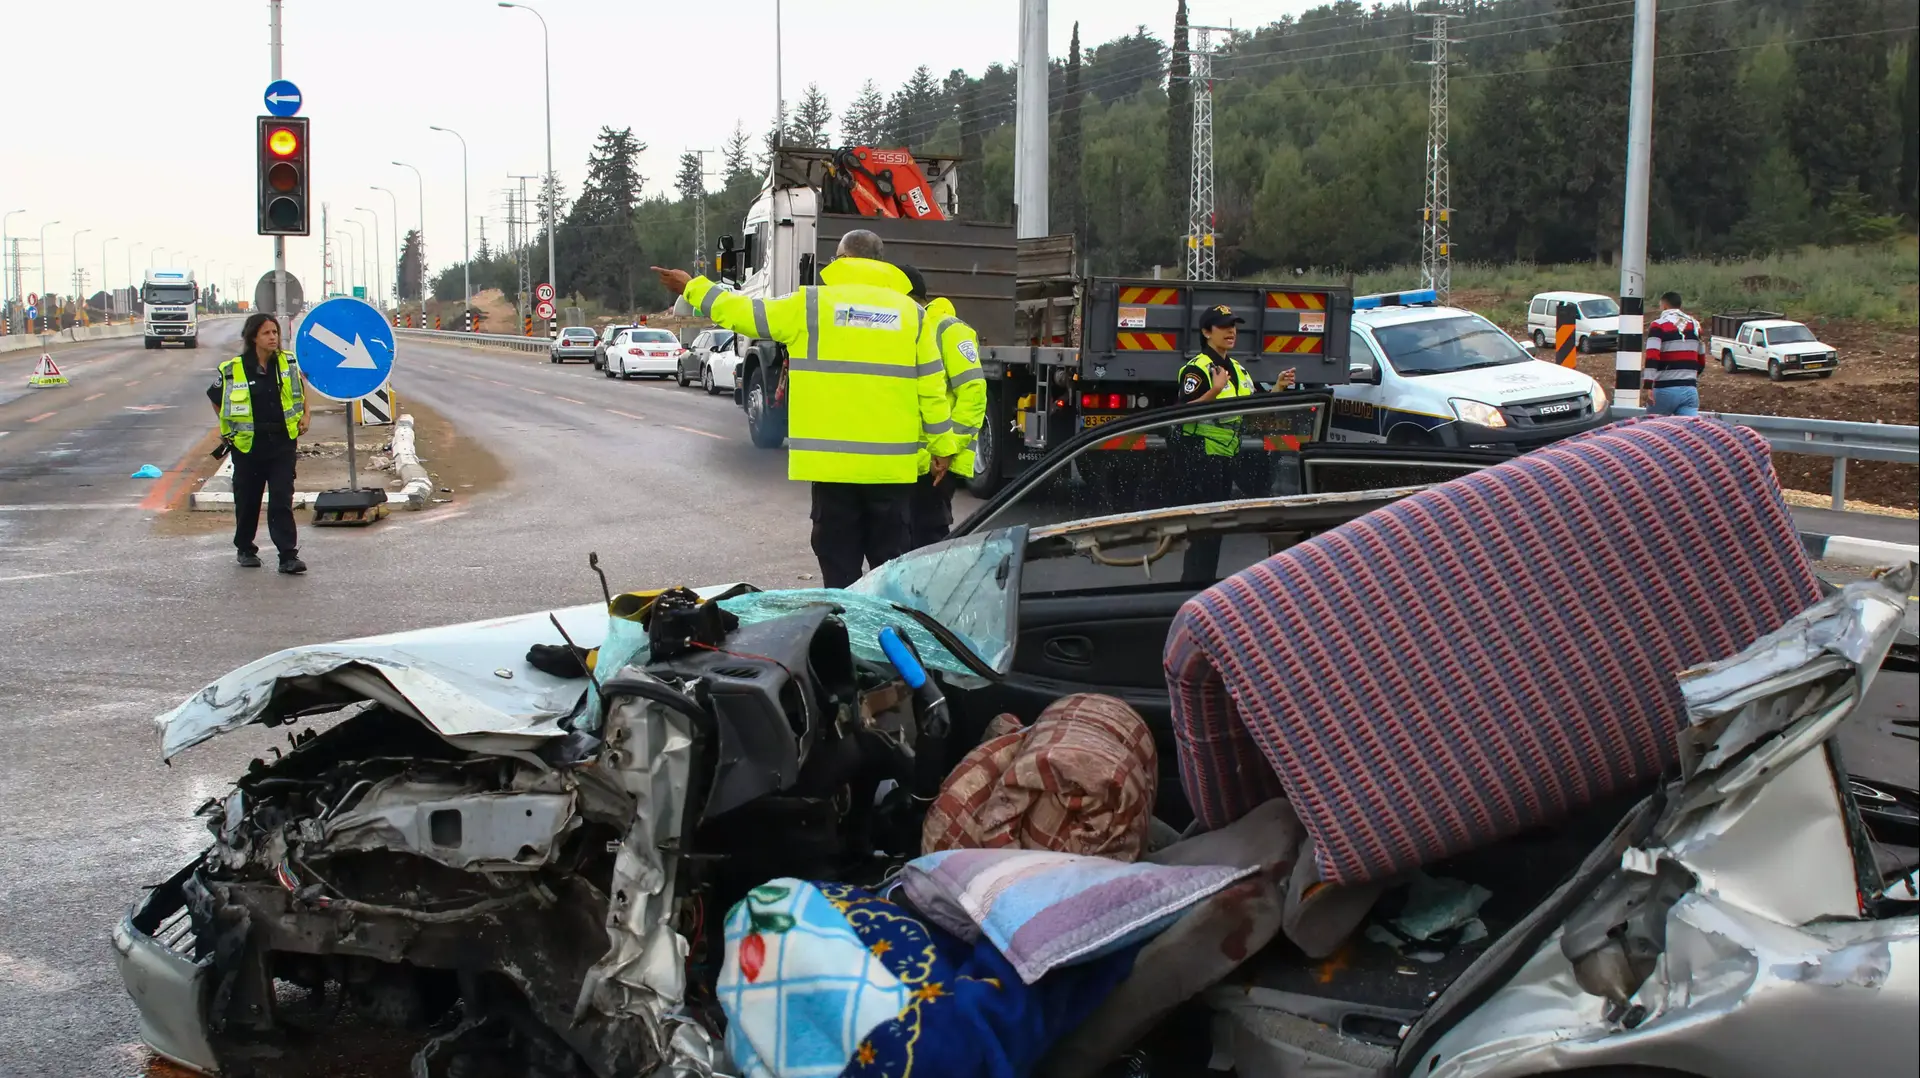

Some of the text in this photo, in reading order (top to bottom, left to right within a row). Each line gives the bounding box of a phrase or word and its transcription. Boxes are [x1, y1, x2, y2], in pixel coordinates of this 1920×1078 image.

[872, 153, 906, 163] FASSI
[540, 288, 552, 297] 70
[1540, 404, 1570, 415] ISUZU
